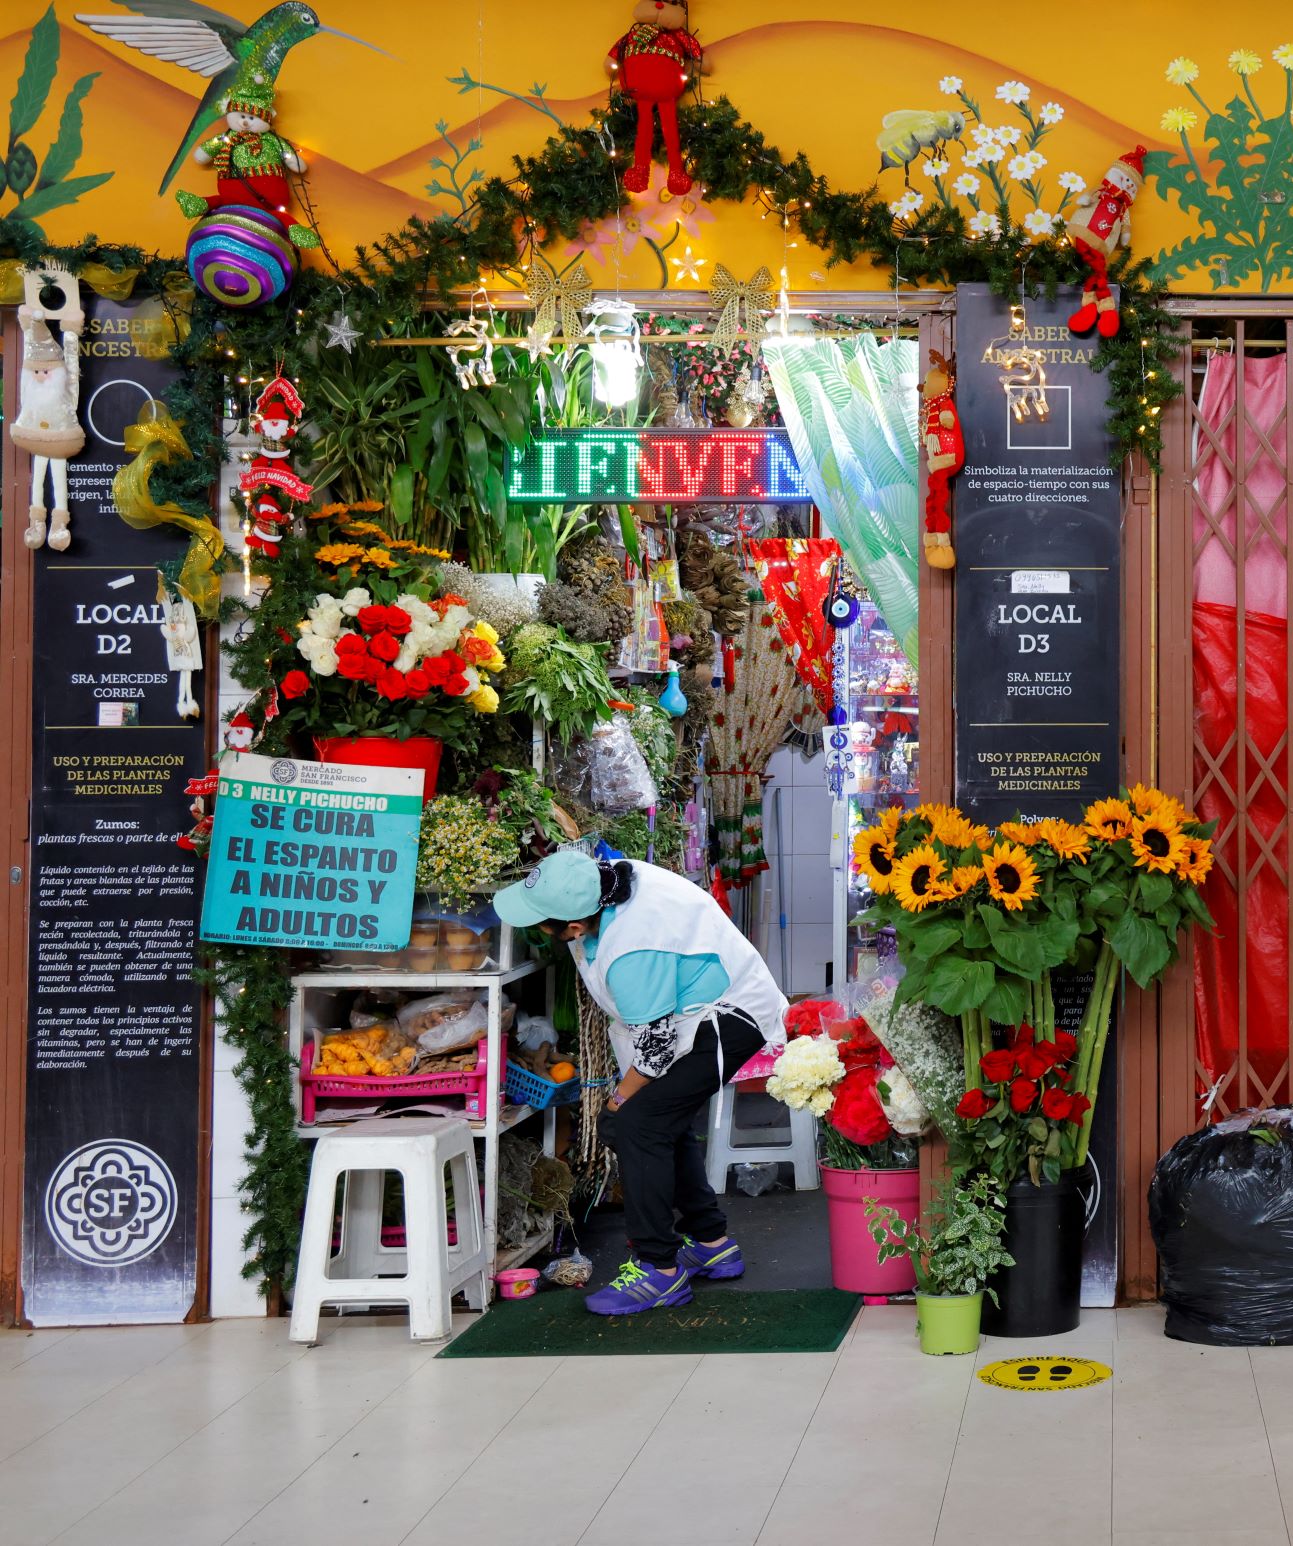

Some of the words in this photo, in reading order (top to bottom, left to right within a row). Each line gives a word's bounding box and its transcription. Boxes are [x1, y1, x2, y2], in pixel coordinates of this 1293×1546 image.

[965, 466, 1017, 475] Simboliza
[1019, 466, 1028, 474] la
[1031, 466, 1113, 475] materialización
[267, 473, 296, 488] NAVIDAD
[968, 480, 981, 488] de
[984, 480, 1067, 490] espacio-tiempo
[989, 494, 1023, 502] cuatro
[1025, 493, 1089, 502] direcciones.
[77, 605, 165, 623] LOCAL
[998, 605, 1081, 623] LOCAL
[98, 635, 131, 654] D2
[1019, 634, 1049, 653] D3
[72, 674, 97, 683] SRA.
[101, 674, 167, 683] MERCEDES
[1008, 673, 1031, 682] SRA.
[1035, 673, 1072, 681] NELLY
[94, 688, 145, 697] CORREA
[1007, 686, 1071, 695] PICHUCHO
[53, 757, 79, 766] USO
[82, 757, 91, 766] Y
[93, 754, 184, 766] PREPARACIÓN
[978, 753, 1002, 762] USO
[1005, 753, 1013, 762] Y
[1015, 751, 1101, 762] PREPARACIÓN
[302, 765, 342, 774] MERCADO
[991, 767, 1006, 776] DE
[1010, 767, 1030, 776] LAS
[1034, 767, 1087, 776] PLANTAS
[67, 771, 84, 780] DE
[87, 771, 110, 780] LAS
[113, 770, 170, 780] PLANTAS
[320, 774, 367, 783] FRANCISCO
[74, 785, 162, 794] MEDICINALES
[998, 781, 1080, 790] MEDICINALES
[219, 782, 229, 796] D
[232, 783, 243, 798] 3
[251, 786, 295, 803] NELLY
[300, 791, 388, 811] PICHUCHO
[96, 820, 139, 829] Zumos:
[251, 804, 286, 830] SE
[293, 808, 375, 837] CURA
[38, 834, 76, 845] plantas
[78, 833, 114, 844] frescas
[126, 834, 153, 844] parte
[156, 833, 168, 842] de
[228, 837, 256, 863] EL
[264, 840, 397, 873] ESPANTO
[40, 866, 71, 875] Líquido
[74, 865, 115, 873] contenido
[142, 865, 165, 874] tejido
[40, 877, 64, 886] frutas
[99, 876, 132, 884] blandas
[162, 876, 194, 885] plantas
[61, 887, 86, 897] puede
[160, 886, 193, 896] presión,
[230, 870, 251, 895] A
[260, 871, 359, 903] NIÑOS
[368, 880, 387, 904] Y
[40, 898, 72, 907] cocción,
[236, 907, 378, 939] ADULTOS
[89, 1189, 131, 1217] SF
[1002, 1356, 1053, 1365] ESPERE
